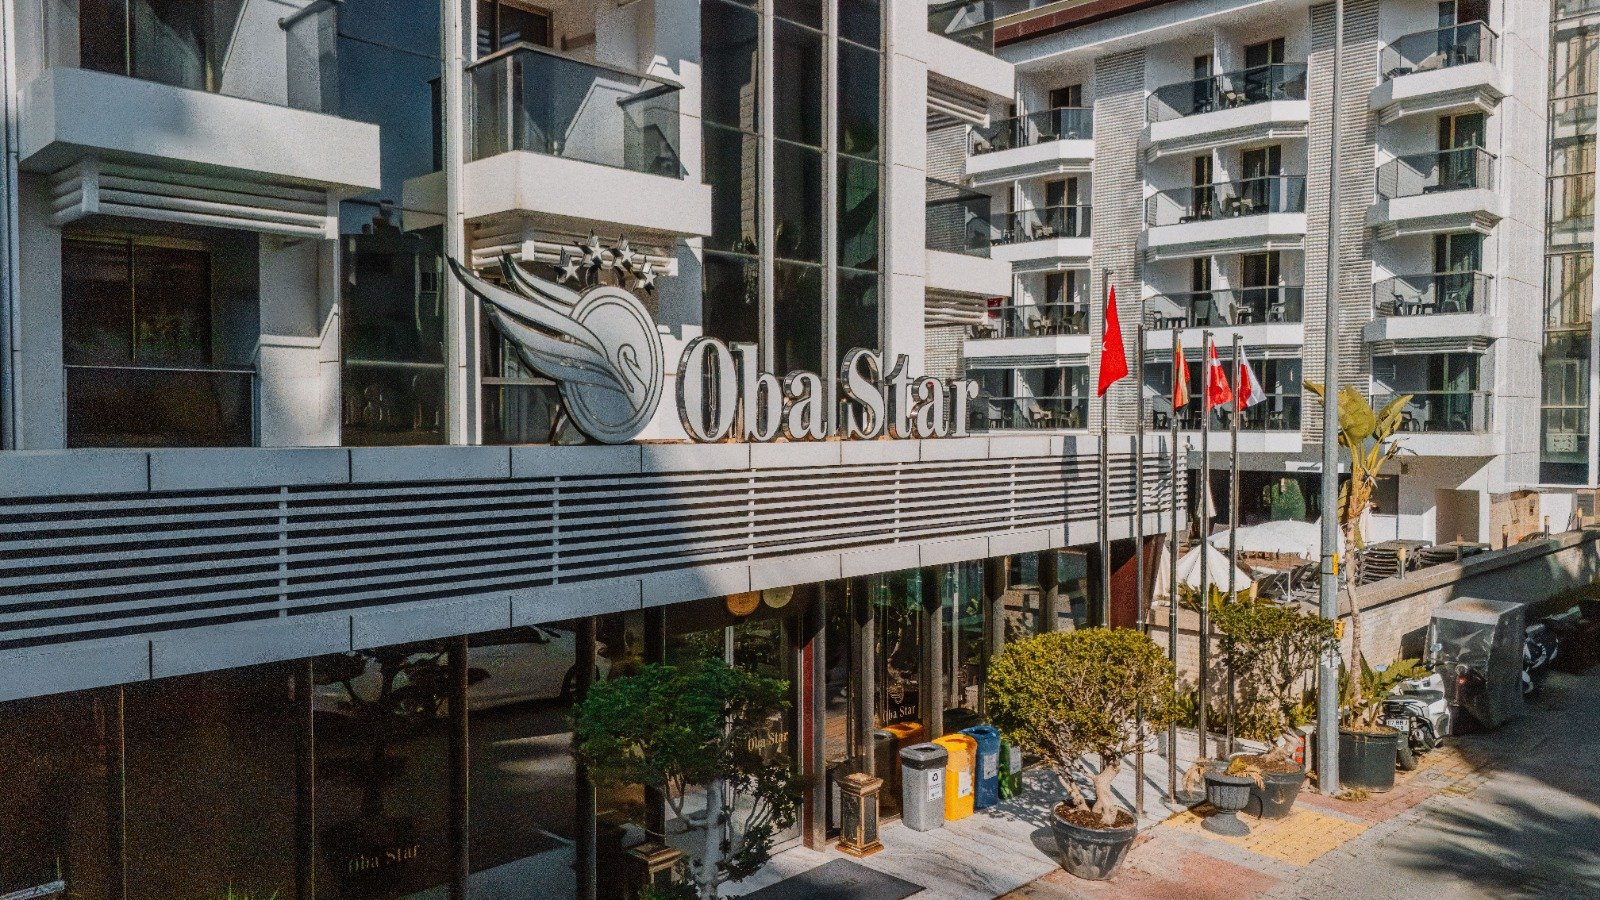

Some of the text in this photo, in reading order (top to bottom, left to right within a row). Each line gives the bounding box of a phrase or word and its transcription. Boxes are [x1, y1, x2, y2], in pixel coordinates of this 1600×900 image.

[675, 336, 979, 443] Oba Star
[881, 705, 916, 724] Oba Star
[747, 731, 789, 751] Oba Star
[347, 844, 421, 874] Oba Star
